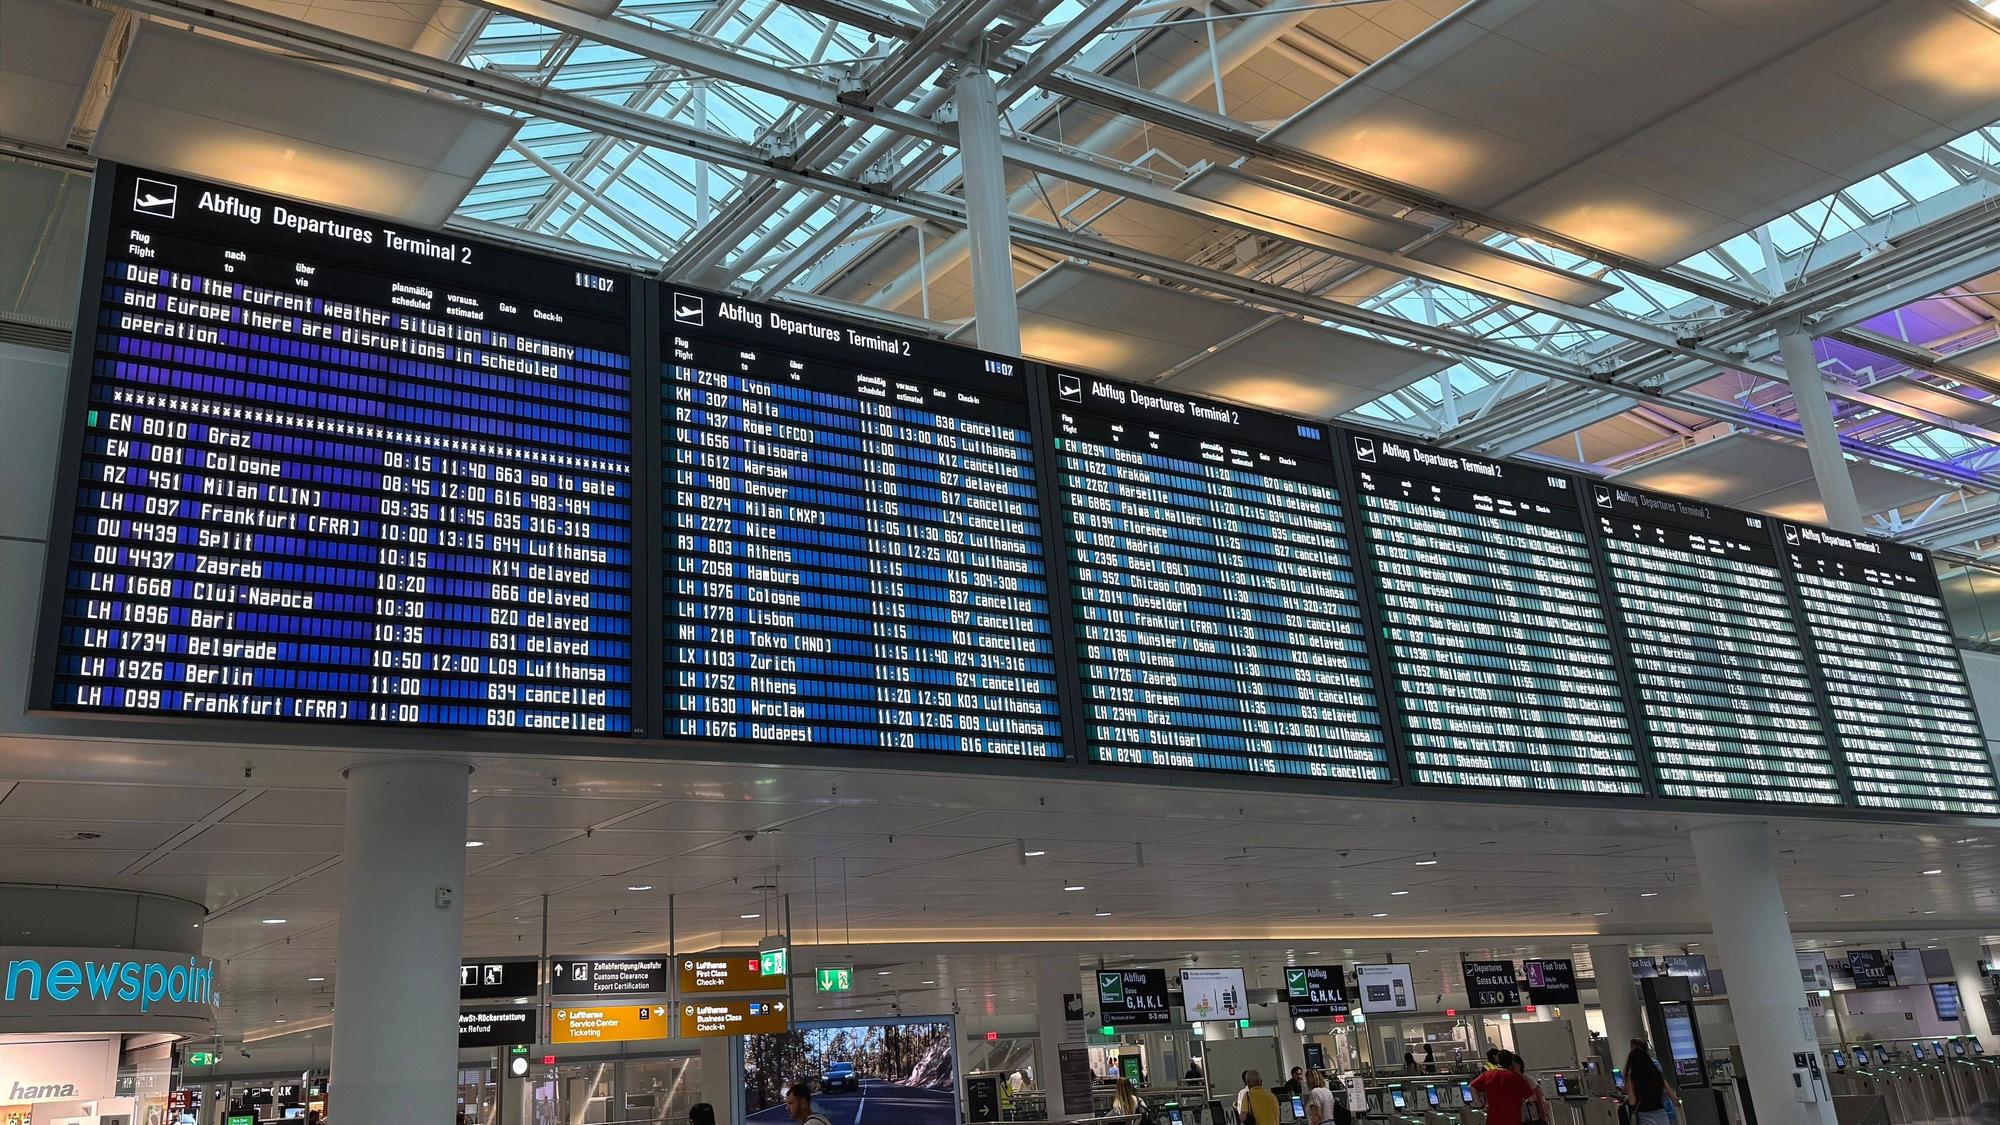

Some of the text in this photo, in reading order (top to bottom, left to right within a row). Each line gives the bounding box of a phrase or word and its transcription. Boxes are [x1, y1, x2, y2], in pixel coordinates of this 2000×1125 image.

[199, 191, 472, 264] Abflug Departures Terminal 2
[130, 230, 150, 244] Flug
[129, 244, 154, 258] Flight
[225, 250, 246, 261] nach
[224, 263, 233, 272] to
[296, 263, 315, 274] über
[296, 276, 308, 287] via
[392, 282, 432, 299] planmäßig
[576, 272, 613, 292] 11:07
[392, 296, 430, 310] scheduled
[448, 295, 478, 306] vorauss.
[500, 303, 516, 313] Gate
[127, 265, 574, 359] Due to the current weather situation in Germany
[447, 306, 483, 320] estimated
[122, 317, 224, 344] operation.
[125, 293, 557, 378] and Europe there are disruptions in scheduled
[719, 302, 911, 356] Abflug Departures Terminal 2
[984, 360, 1013, 376] 11:07
[676, 366, 1014, 440] LH 2248 Lyon 11:00 cancelled
[1092, 381, 1239, 425] Abflug Departures Terminal 2
[743, 399, 930, 444] Malta 13:00
[110, 414, 486, 478] EN 8010 Graz 08:15 11:40
[1066, 440, 1142, 464] EN 8294 Genoa
[1382, 442, 1502, 477] Abflug Departures Terminal 2
[207, 453, 485, 502] Cologne 12:00
[1120, 484, 1265, 519] Marseille 12:15
[1616, 490, 1711, 519] Abflug Departures Terminal 2
[101, 492, 122, 510] LH
[146, 498, 179, 516] 097
[202, 504, 295, 529] Frankfurt
[382, 524, 427, 543] 10:00
[440, 530, 483, 549] 13:15
[530, 540, 606, 562] Lufthansa
[679, 536, 791, 562] A3 Athens
[1802, 528, 1881, 554] Abflug Departures Terminal 2
[493, 560, 588, 584] K14 delayed
[1131, 575, 1169, 592] Chicago
[749, 588, 800, 606] Cologne
[189, 637, 516, 675] Belgrade 12:00 L09
[680, 625, 694, 640] NH
[711, 628, 734, 644] 218
[750, 632, 786, 648] Tokyo
[981, 654, 1024, 671] 314-316
[680, 648, 795, 672] LX Zurich
[1140, 651, 1360, 687] Vienna cancelled
[186, 665, 252, 686] Berlin
[753, 724, 1046, 756] Budapest 11:20 cancelled
[1153, 751, 1274, 772] Bologna 11:45
[594, 962, 662, 971] Zollabfertigung/Ausfuhr
[696, 962, 727, 970] Lufthansa
[1308, 969, 1327, 979] Abflug
[1474, 964, 1502, 972] Departures
[1543, 962, 1567, 970] Fast Track
[4, 954, 214, 1012] newspoint
[620, 972, 648, 980] Clearance
[697, 978, 724, 986] Check-in
[1124, 972, 1146, 984] Abflug
[614, 982, 649, 990] Certification
[570, 1011, 603, 1019] Lufthansa
[697, 1007, 728, 1015] Lufthansa
[697, 1014, 742, 1023] Business Class
[468, 1025, 491, 1033] Refund
[570, 1020, 595, 1028] Service
[570, 1029, 601, 1037] Ticketing
[9, 1081, 74, 1100] hama
